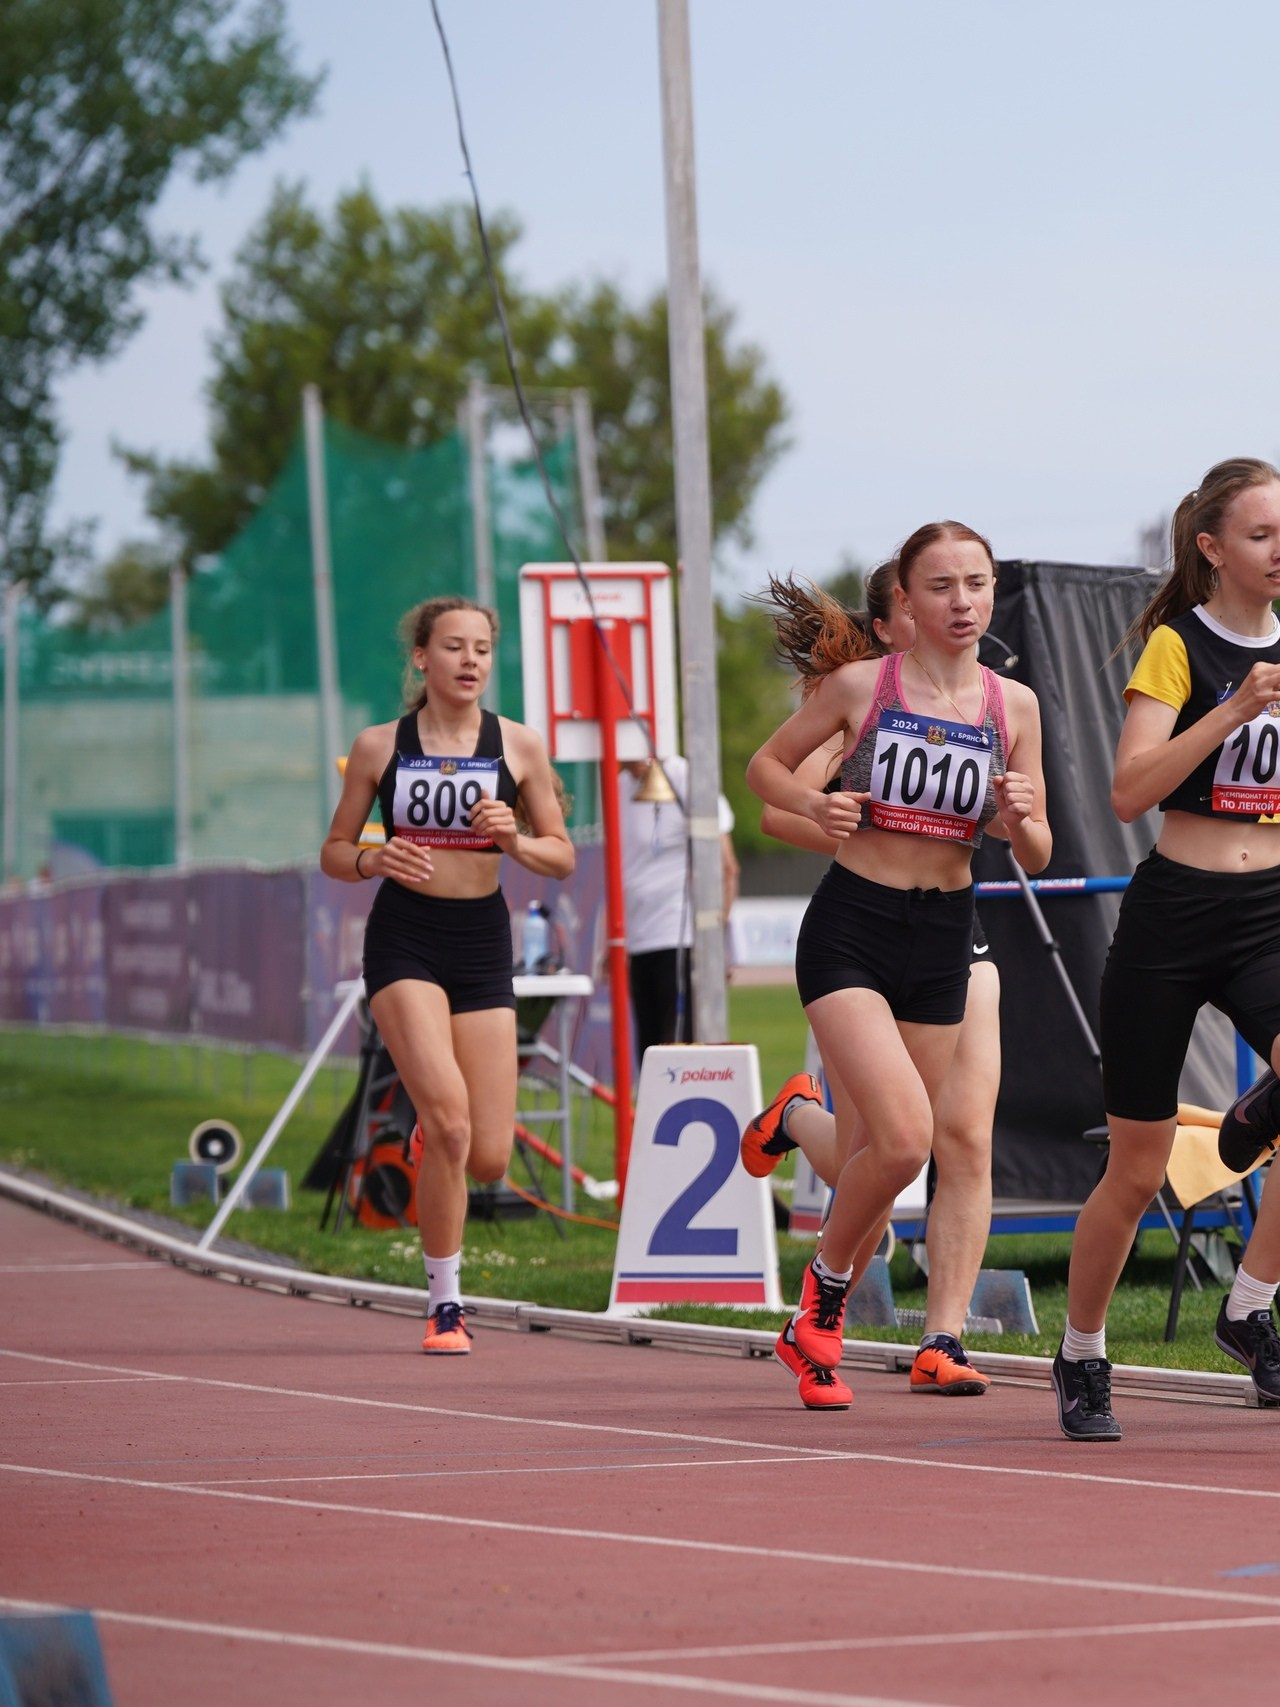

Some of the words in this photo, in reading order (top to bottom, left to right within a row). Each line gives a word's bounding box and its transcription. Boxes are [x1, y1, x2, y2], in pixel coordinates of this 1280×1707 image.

[891, 719, 919, 731] 2024
[409, 759, 432, 768] 2024
[878, 742, 980, 815] 1010
[406, 779, 482, 828] 809
[1220, 800, 1235, 809] ПО
[1238, 800, 1274, 811] ЛЕГКОЙ
[873, 815, 883, 825] ПО
[884, 819, 920, 831] ЛЕГКОЙ
[921, 824, 966, 838] АТЛЕТИКЕ
[915, 815, 953, 825] ПЕРВЕНСТВА
[415, 835, 447, 844] ЛЕГКОЙ
[680, 1067, 735, 1084] polanik
[647, 1097, 740, 1256] 2
